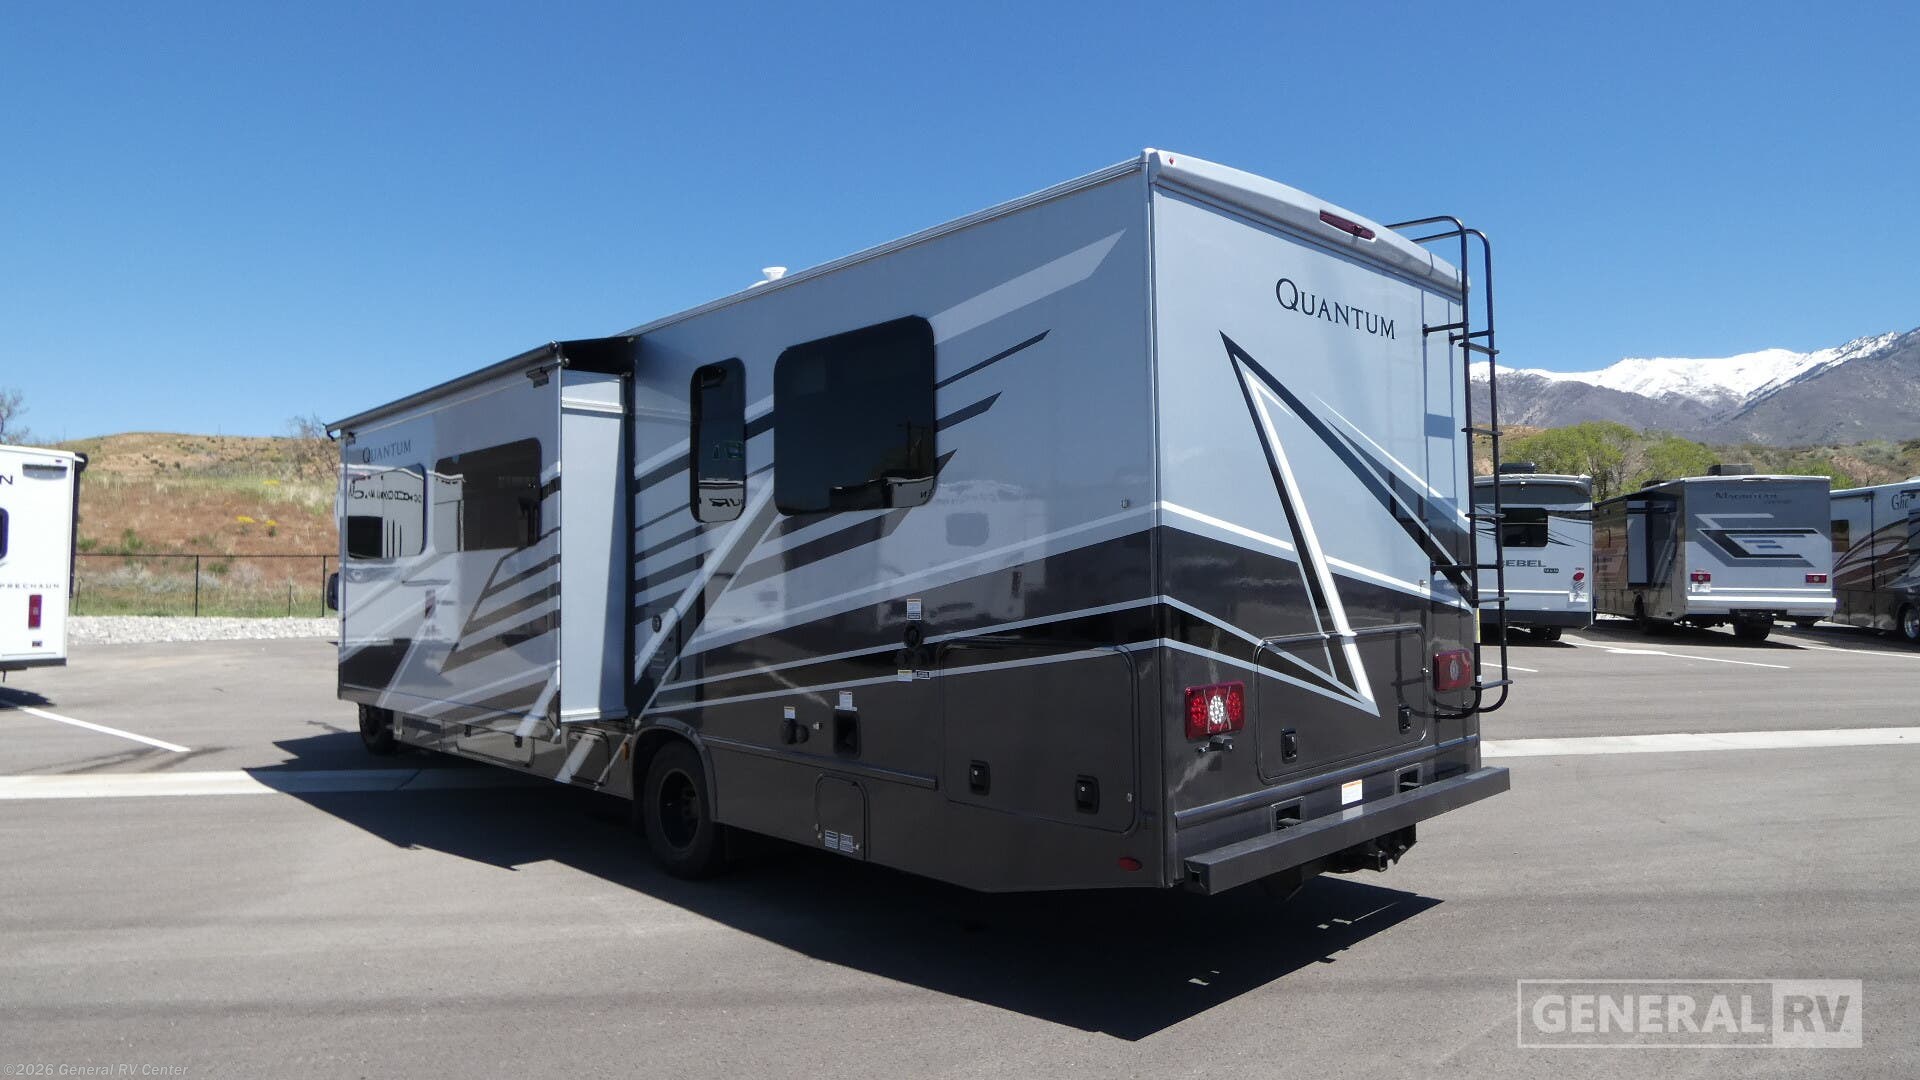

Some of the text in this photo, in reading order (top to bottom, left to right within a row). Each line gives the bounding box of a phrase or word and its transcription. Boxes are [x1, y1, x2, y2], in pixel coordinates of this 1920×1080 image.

[1275, 277, 1396, 340] QUANTUM
[362, 440, 411, 464] QUANTUM
[1496, 559, 1547, 568] EBEL
